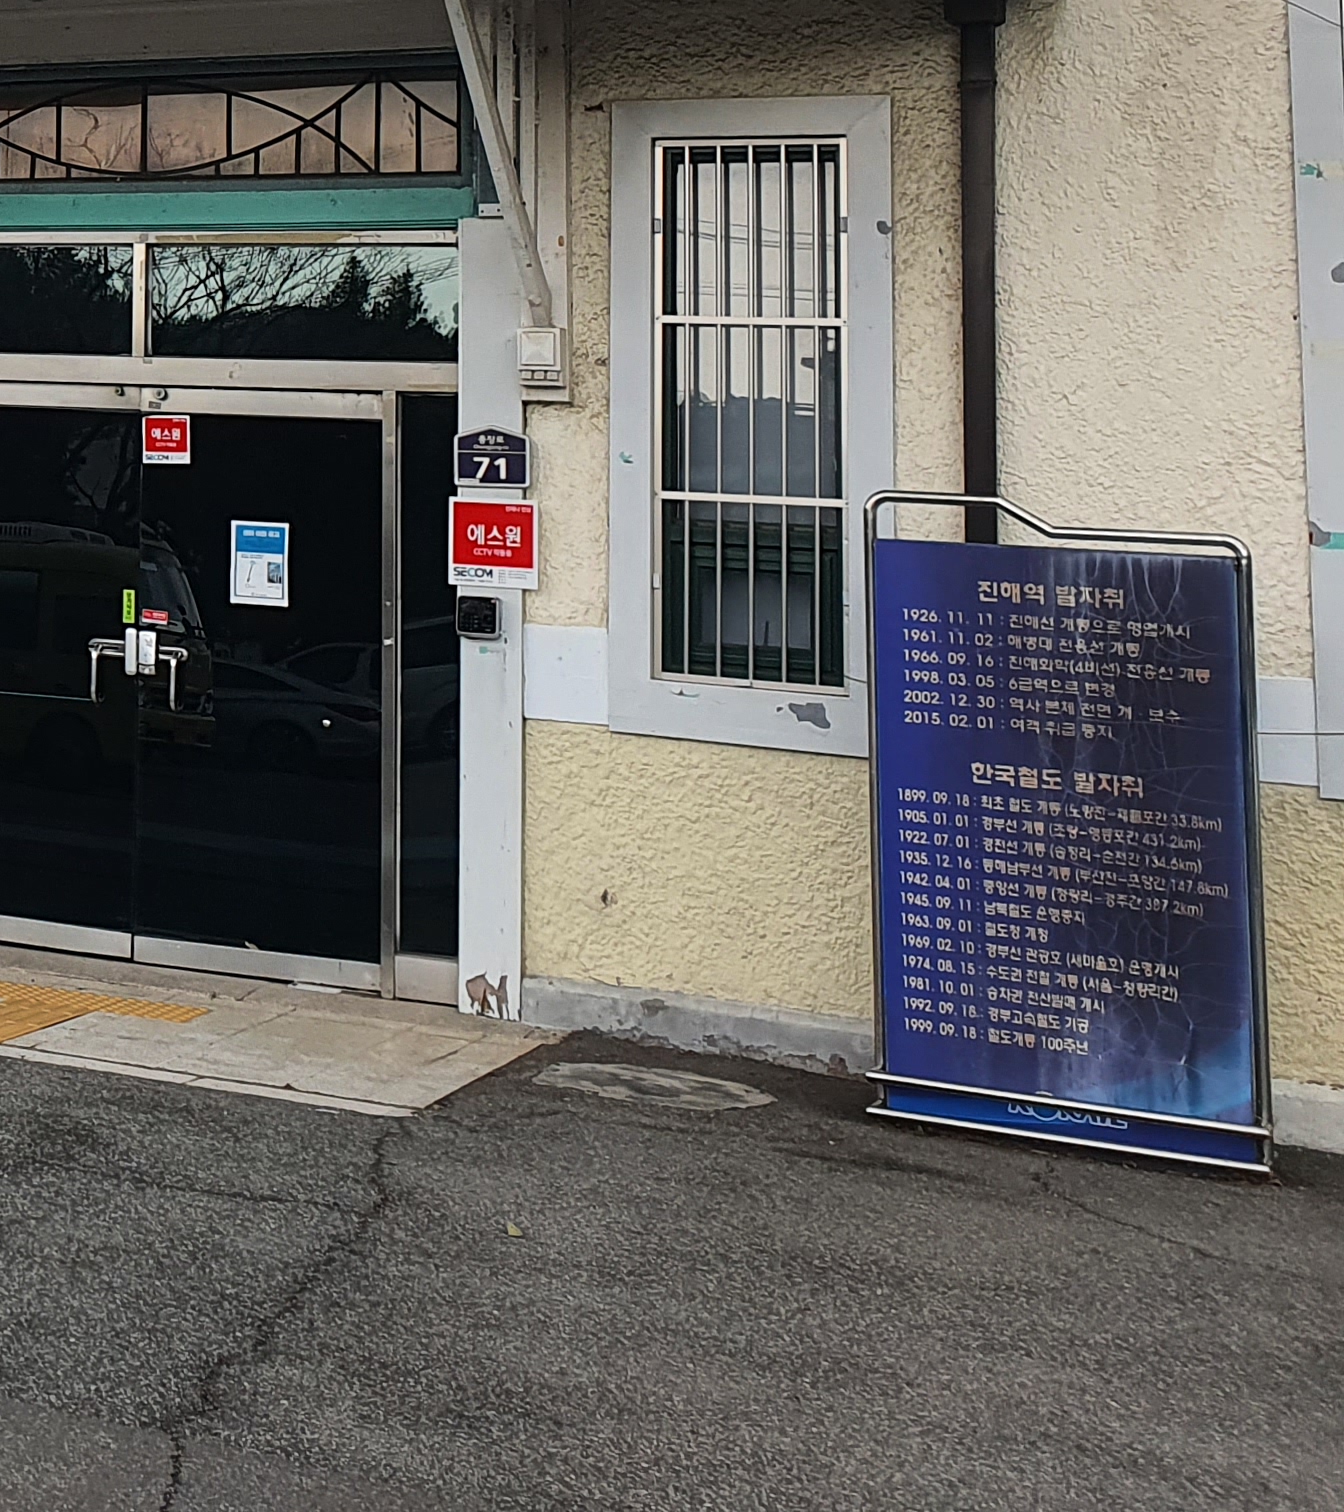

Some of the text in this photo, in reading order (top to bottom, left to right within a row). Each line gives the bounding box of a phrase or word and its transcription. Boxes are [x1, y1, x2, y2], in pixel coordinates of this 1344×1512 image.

[473, 457, 506, 480] 71
[467, 524, 521, 547] 에스원
[473, 548, 492, 556] CCTV
[453, 567, 493, 578] SECOM
[977, 581, 1124, 609] 진해역 발자취
[903, 608, 1190, 639] 1926. 11. 11 진해선 개통으로 영업개시
[903, 629, 942, 643] 1961.
[948, 632, 970, 645] 11.
[975, 634, 993, 646] 02
[1110, 642, 1140, 657] 개통
[904, 649, 942, 663] 1966.
[948, 652, 970, 665] 09.
[977, 654, 994, 667] 16
[1180, 667, 1210, 683] 개통
[904, 670, 943, 684] 1998.
[948, 673, 970, 686] 03.
[976, 675, 994, 687] 05
[904, 690, 943, 704] 2002.
[950, 693, 971, 707] 12.
[977, 696, 995, 708] 30
[1010, 698, 1040, 712] 역사
[904, 711, 944, 725] 2015.
[949, 714, 972, 727] 02.
[977, 716, 993, 729] 01
[1011, 718, 1039, 734] 여객
[971, 762, 1143, 798] 한국철도 발자취
[898, 788, 929, 803] 1899.
[933, 792, 951, 804] 09.
[956, 794, 970, 806] 18
[981, 795, 1005, 810] 최초
[1171, 814, 1222, 832] 33.8km)
[898, 809, 930, 823] 1905.
[933, 813, 952, 826] 01.
[955, 815, 969, 827] 01
[982, 816, 1017, 833] 경부선
[899, 829, 930, 844] 1922.
[934, 834, 952, 847] 07.
[956, 836, 969, 848] 01
[899, 850, 931, 865] 1935.
[936, 854, 952, 867] 12.
[957, 856, 972, 869] 16
[900, 871, 931, 886] 1942.
[935, 875, 953, 888] 04.
[957, 878, 970, 890] 01
[901, 892, 932, 907] 1945.
[936, 896, 954, 909] 09.
[959, 899, 971, 911] 11
[901, 913, 933, 928] 1963.
[936, 917, 955, 930] 09.
[958, 920, 971, 932] 01
[902, 934, 933, 949] 1969.
[937, 938, 955, 951] 02.
[960, 941, 974, 954] 10
[986, 943, 1021, 960] 경부선
[1025, 947, 1061, 965] 관광호
[903, 955, 934, 970] 1974.
[938, 959, 956, 973] 08.
[961, 962, 975, 975] 15
[986, 965, 1022, 982] 수도권
[903, 976, 934, 991] 1981.
[939, 980, 956, 994] 10.
[960, 983, 974, 996] 01
[1080, 997, 1105, 1014] 개시
[904, 1018, 936, 1033] 1999.
[940, 1023, 958, 1037] 09.
[962, 1026, 976, 1039] 18
[1041, 1036, 1088, 1055] 100주년
